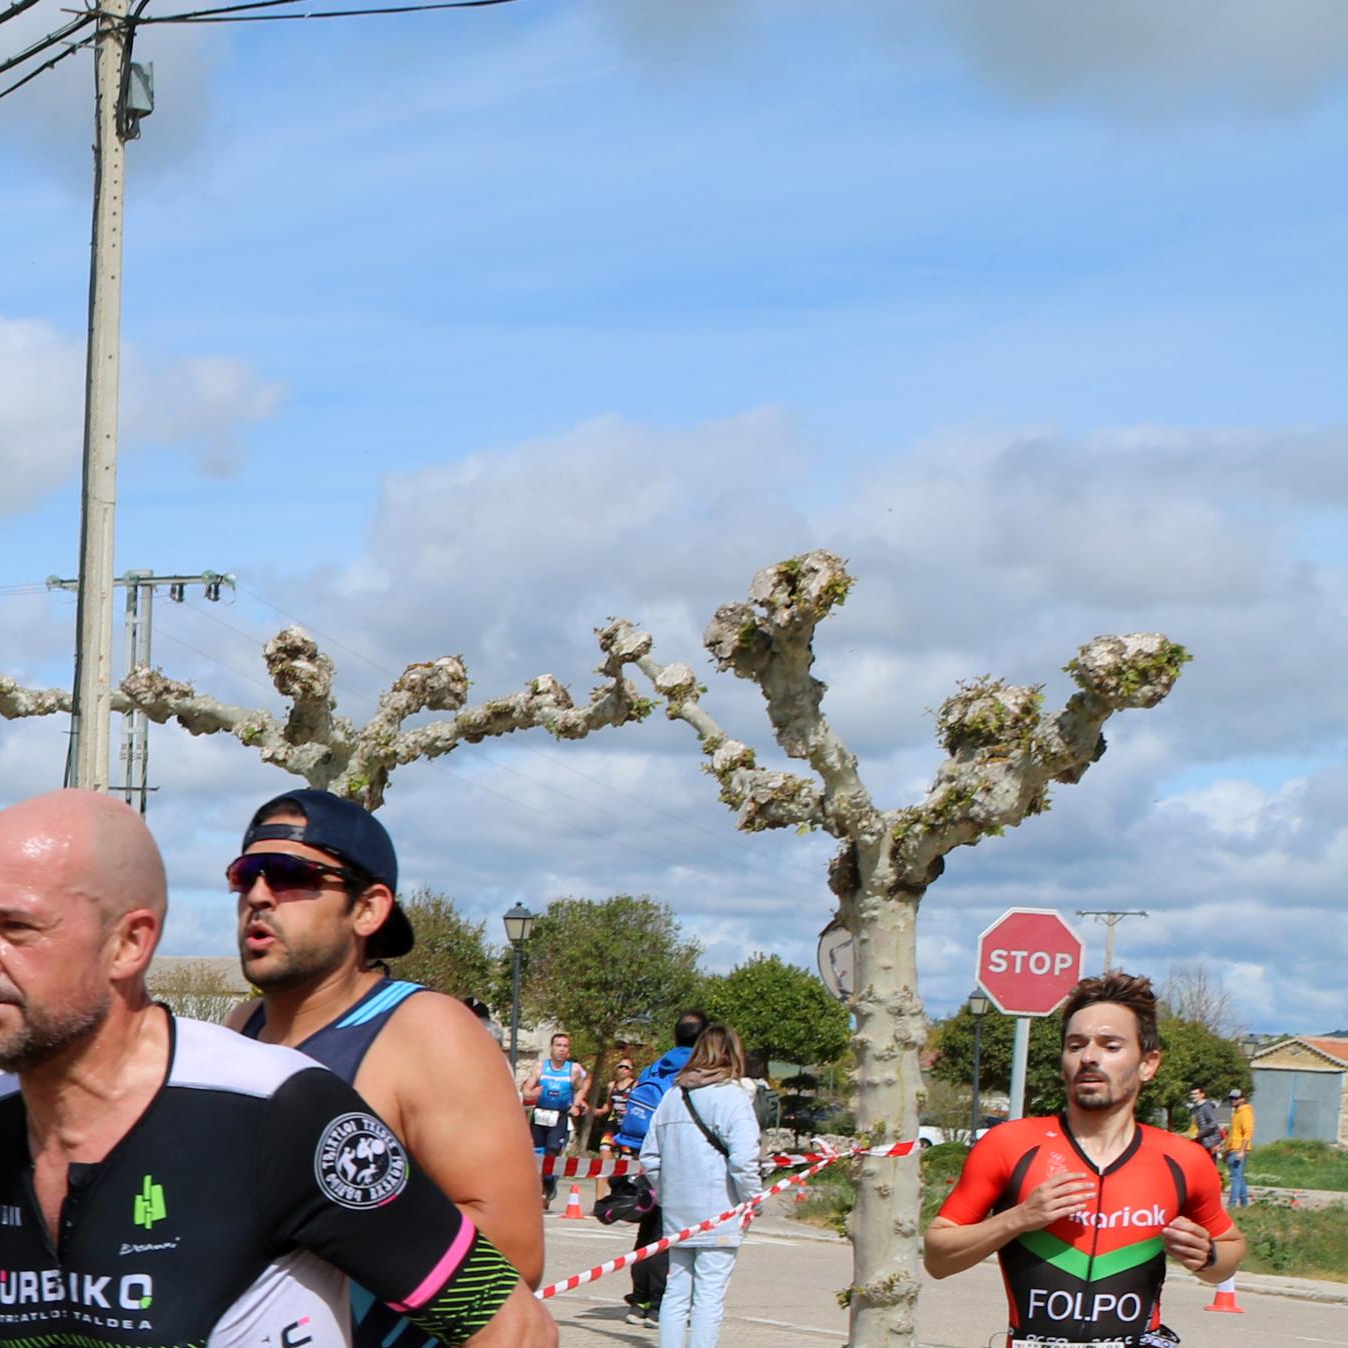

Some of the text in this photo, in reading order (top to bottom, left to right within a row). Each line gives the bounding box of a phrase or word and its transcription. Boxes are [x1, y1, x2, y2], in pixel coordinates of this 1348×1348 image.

[988, 949, 1073, 976] STOP
[0, 1269, 153, 1310] URBIKO
[73, 1311, 153, 1329] TALDEA
[1027, 1288, 1141, 1322] FOLPO
